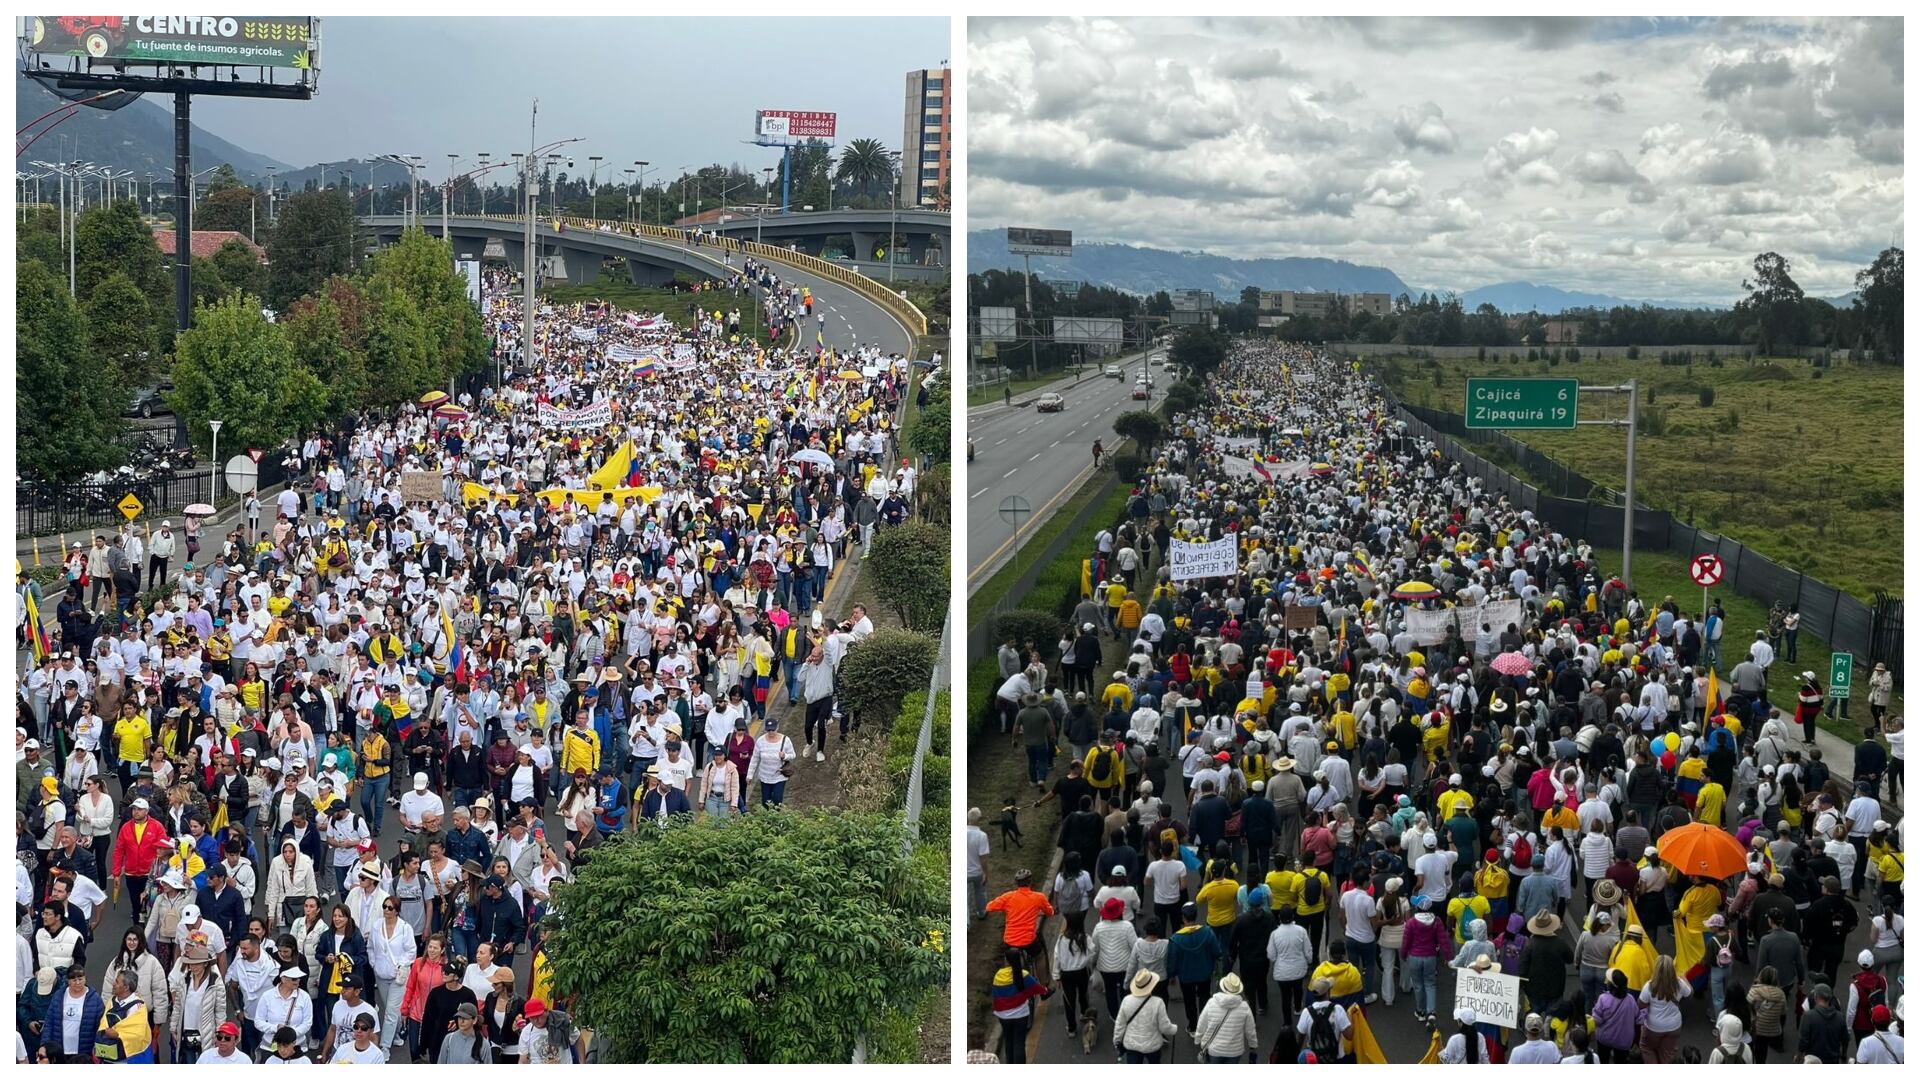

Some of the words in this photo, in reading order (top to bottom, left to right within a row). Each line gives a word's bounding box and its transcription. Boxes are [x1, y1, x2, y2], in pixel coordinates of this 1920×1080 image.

[136, 16, 239, 37] CENTRO
[135, 40, 148, 49] Tu
[150, 41, 182, 52] fuente
[184, 42, 196, 51] de
[198, 43, 238, 54] insumos
[765, 112, 835, 120] DISPONIBLE
[771, 122, 785, 131] bpl
[1476, 387, 1521, 403] Cajicá
[1557, 388, 1568, 401] 6
[540, 410, 558, 419] POR
[575, 406, 610, 419] APOYAR
[1475, 406, 1544, 421] Zipaquirá
[1551, 407, 1567, 420] 19
[540, 419, 557, 427] LAS
[559, 415, 612, 427] REFORMAS
[1836, 658, 1848, 667] Pr
[1836, 671, 1845, 682] 8
[1466, 975, 1504, 997] FUERA
